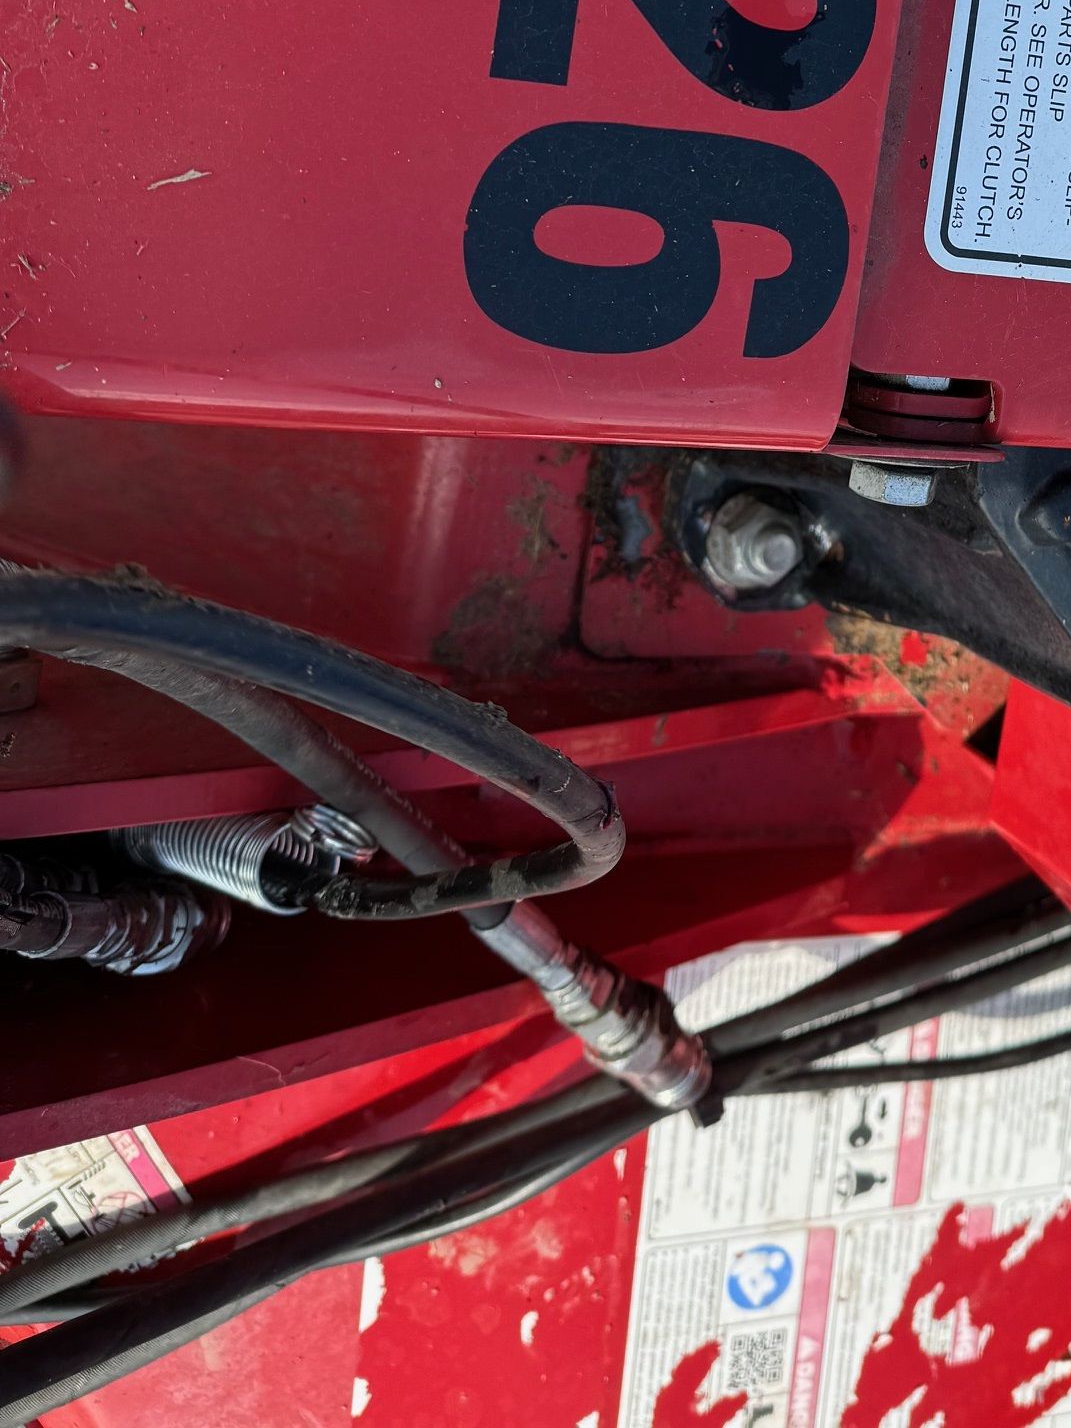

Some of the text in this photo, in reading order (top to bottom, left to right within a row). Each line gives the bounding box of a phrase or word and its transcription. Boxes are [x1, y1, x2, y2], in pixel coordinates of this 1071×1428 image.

[1026, 23, 1047, 69] SEE
[988, 91, 1010, 139] FOR
[1049, 73, 1069, 122] SLIP
[1006, 75, 1040, 221] OPERATOR'S
[951, 186, 968, 229] 91443
[974, 145, 1002, 243] CLUTCH.
